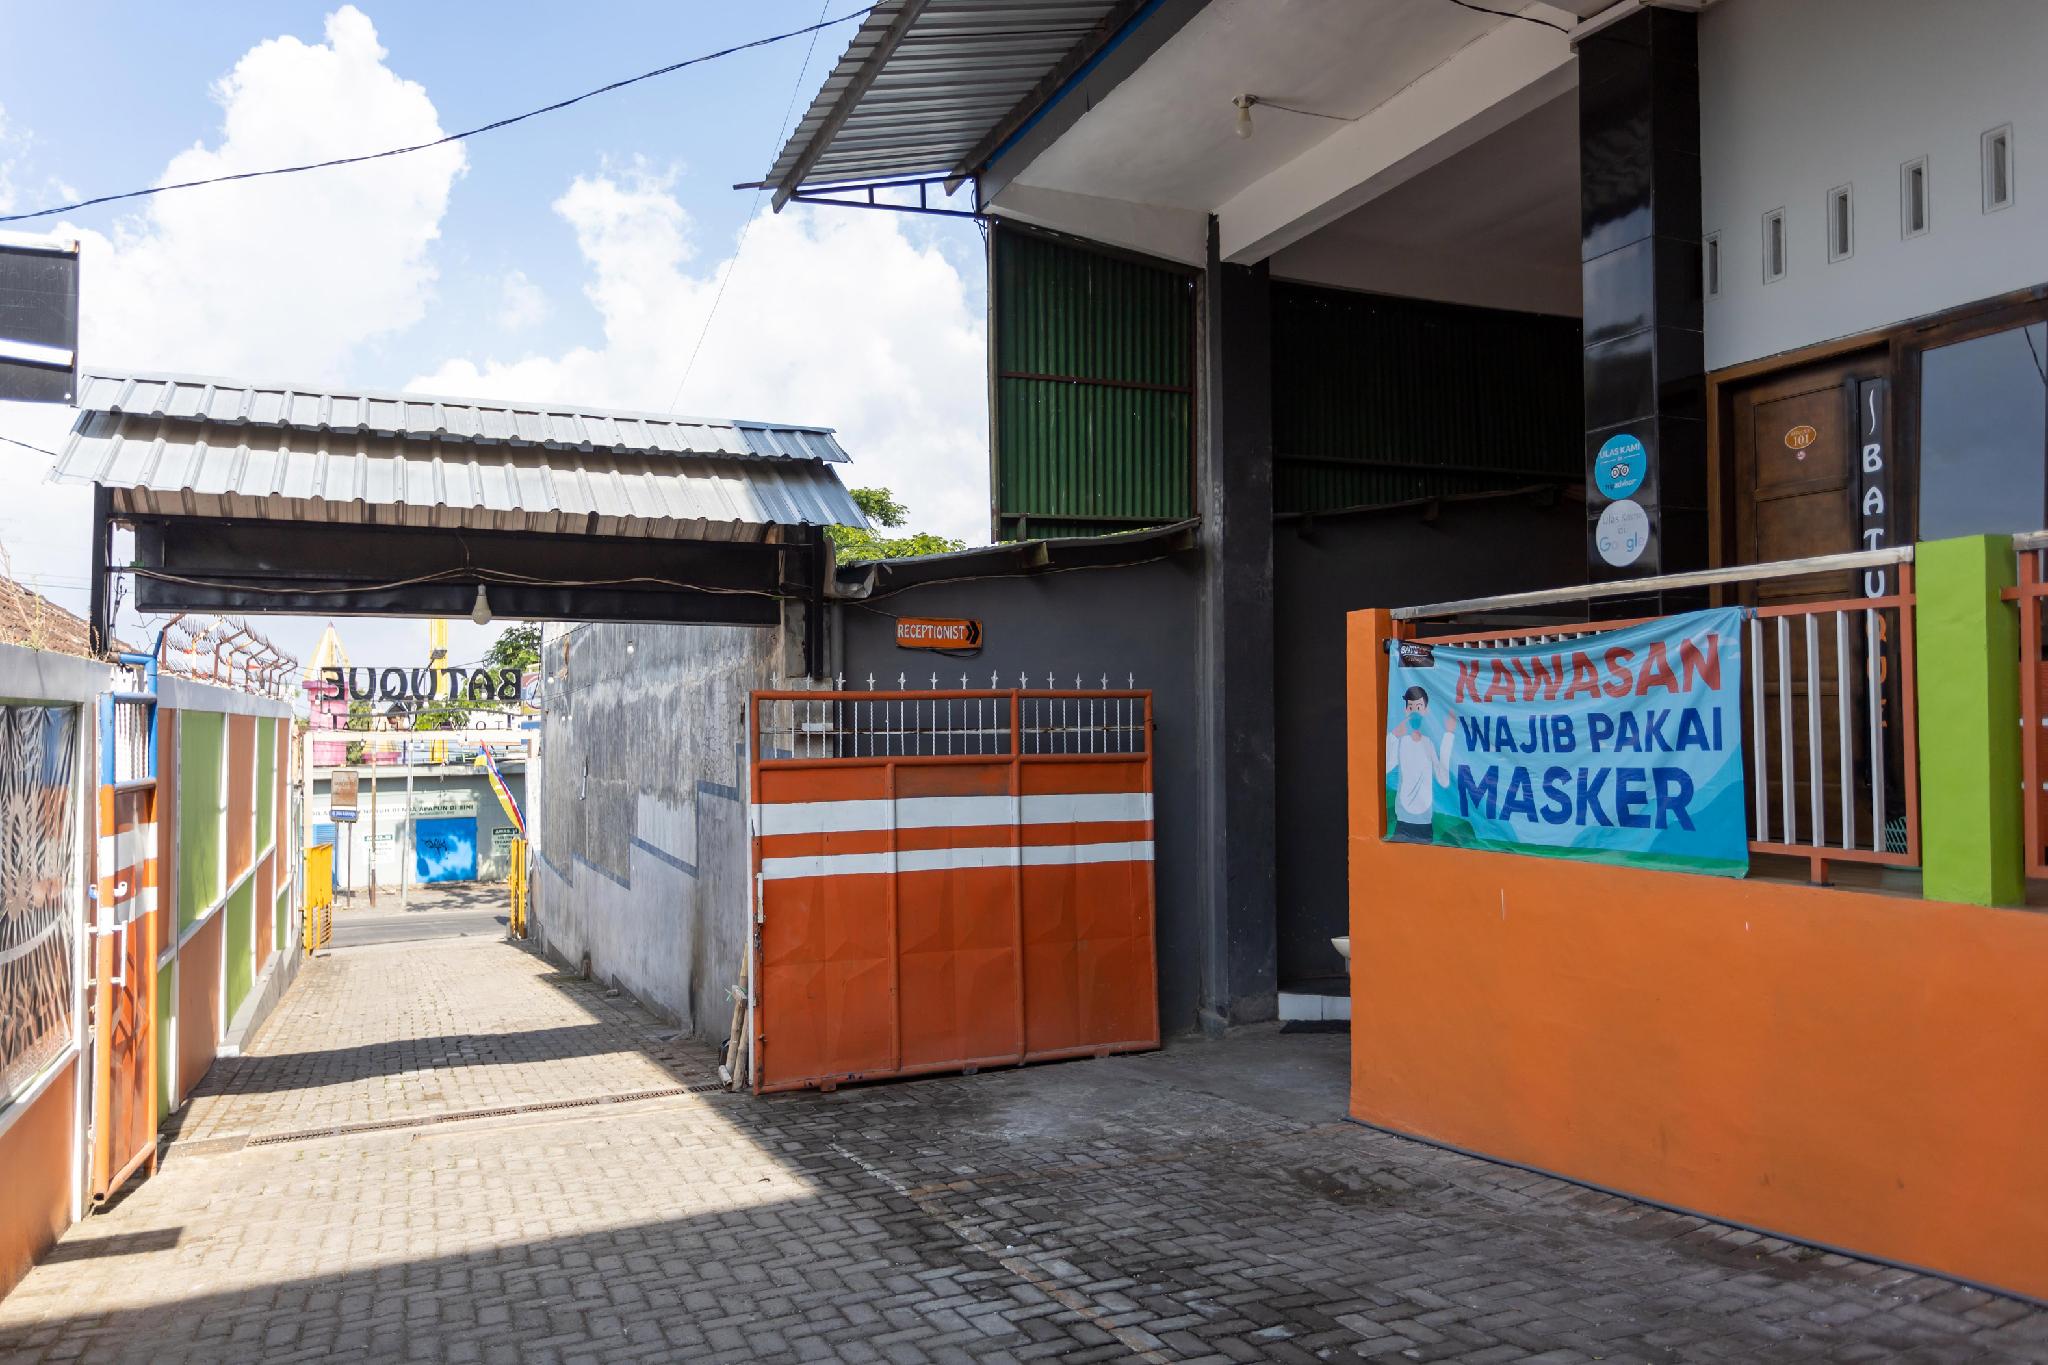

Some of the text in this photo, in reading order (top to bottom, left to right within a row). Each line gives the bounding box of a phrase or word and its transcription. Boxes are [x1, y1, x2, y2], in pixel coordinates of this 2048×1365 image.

[1599, 442, 1641, 459] ULAS KAMI
[1600, 531, 1645, 553] Gogle
[897, 624, 965, 640] RECEPTIONIST
[1455, 633, 1721, 704] KAWASAN
[1459, 706, 1724, 754] WAJIB PAKAI
[1457, 764, 1697, 832] MASKER
